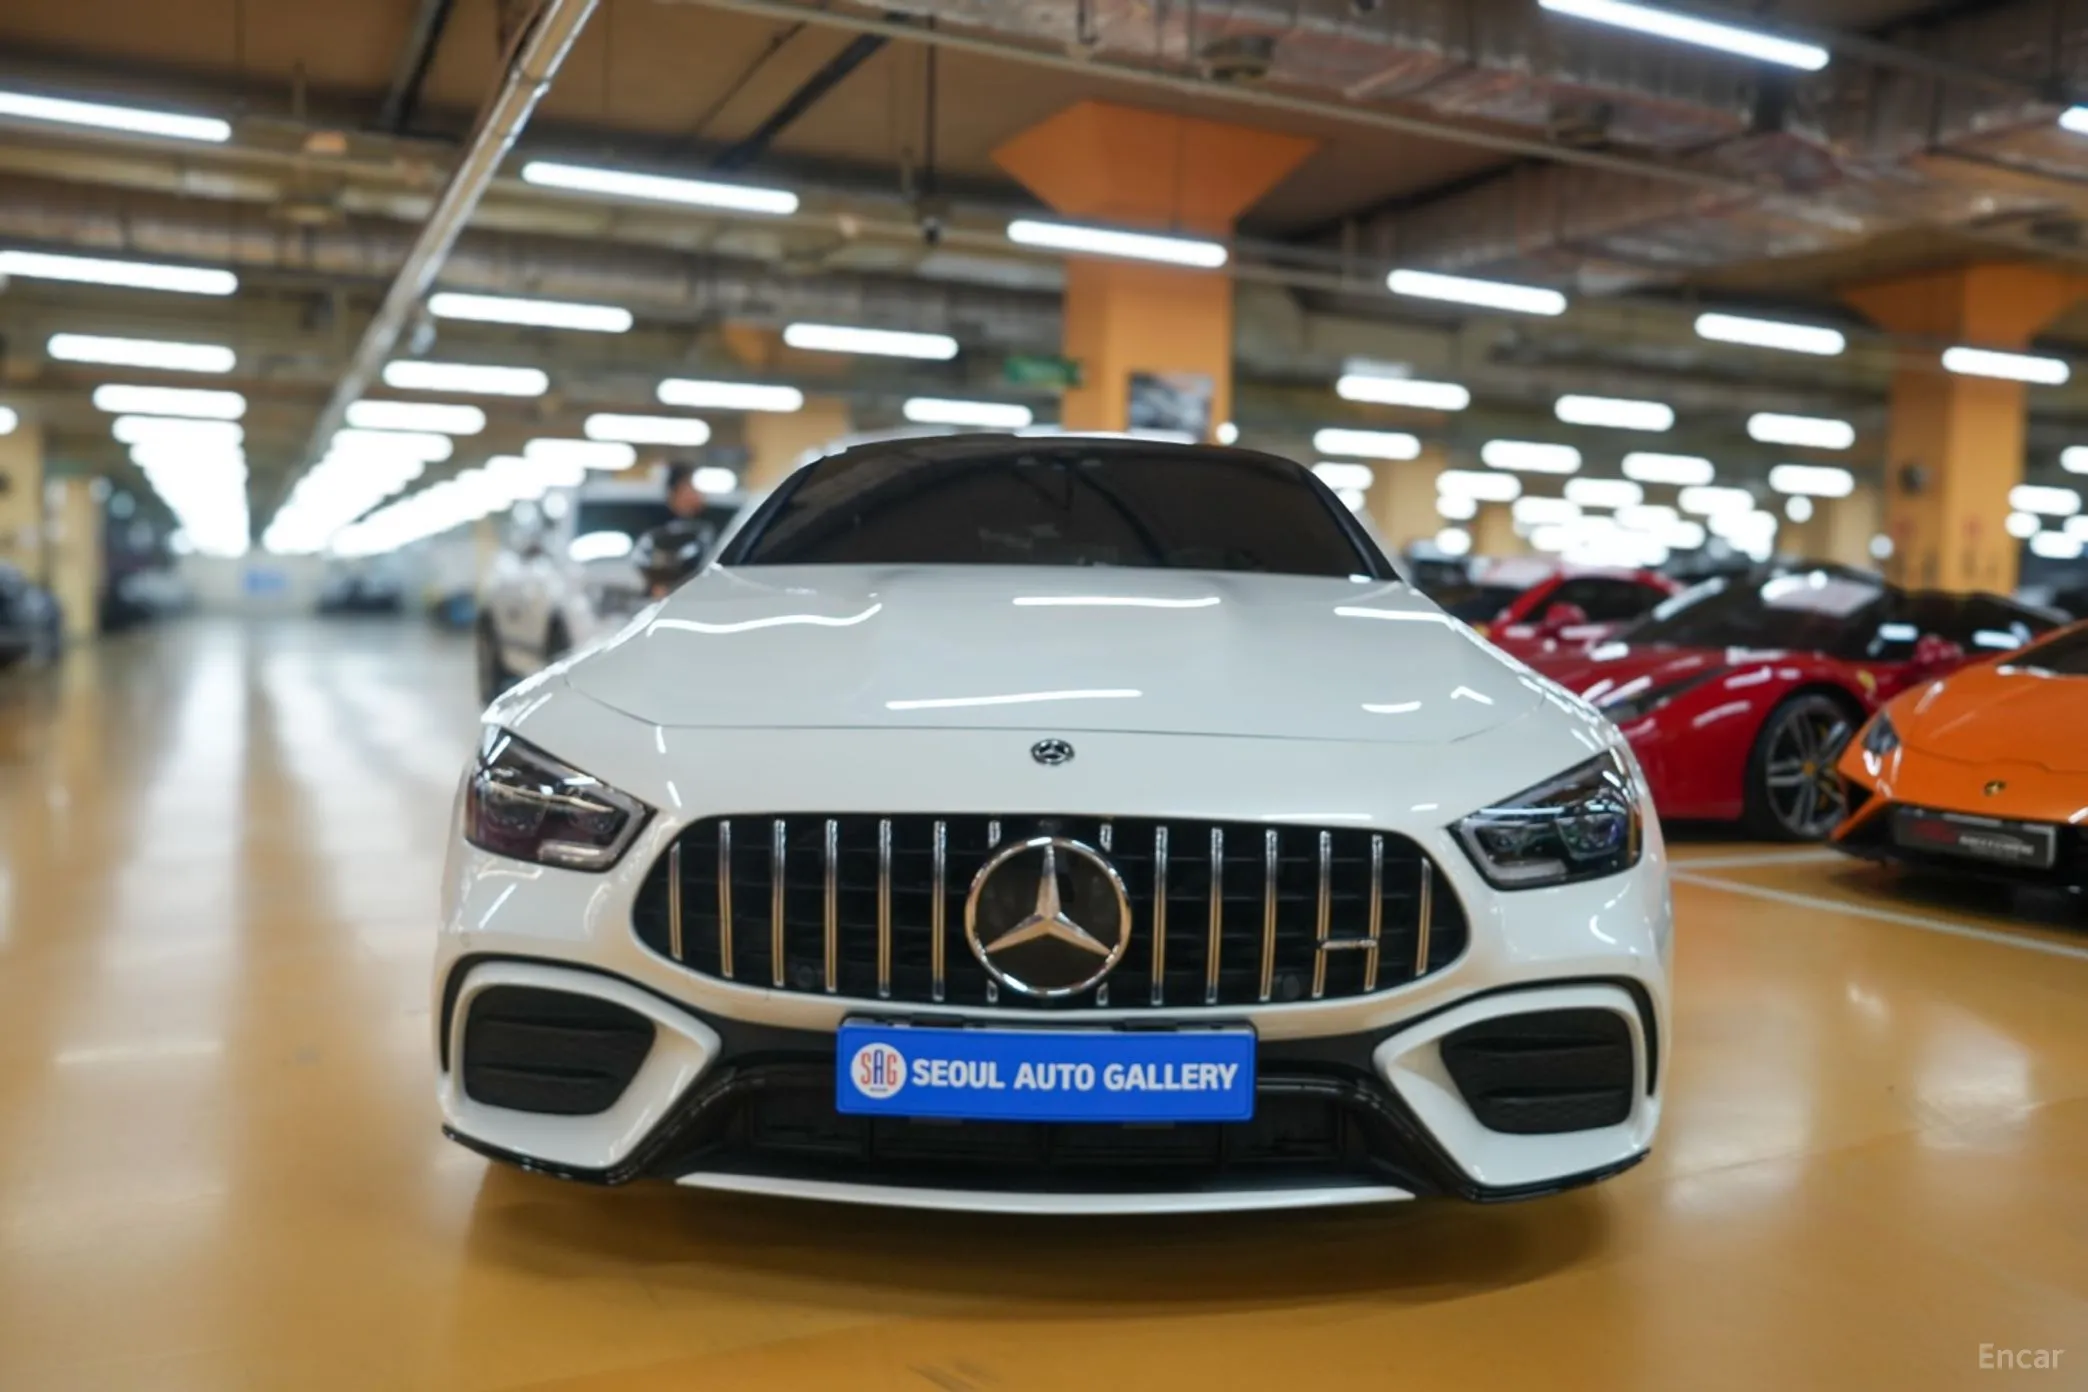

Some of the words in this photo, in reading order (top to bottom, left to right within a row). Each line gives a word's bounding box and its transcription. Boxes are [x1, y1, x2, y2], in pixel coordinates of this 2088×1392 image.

[860, 1049, 898, 1086] SAG
[911, 1059, 1005, 1089] SEOUL
[1013, 1062, 1095, 1091] AUTO
[1103, 1062, 1239, 1091] GALLERY
